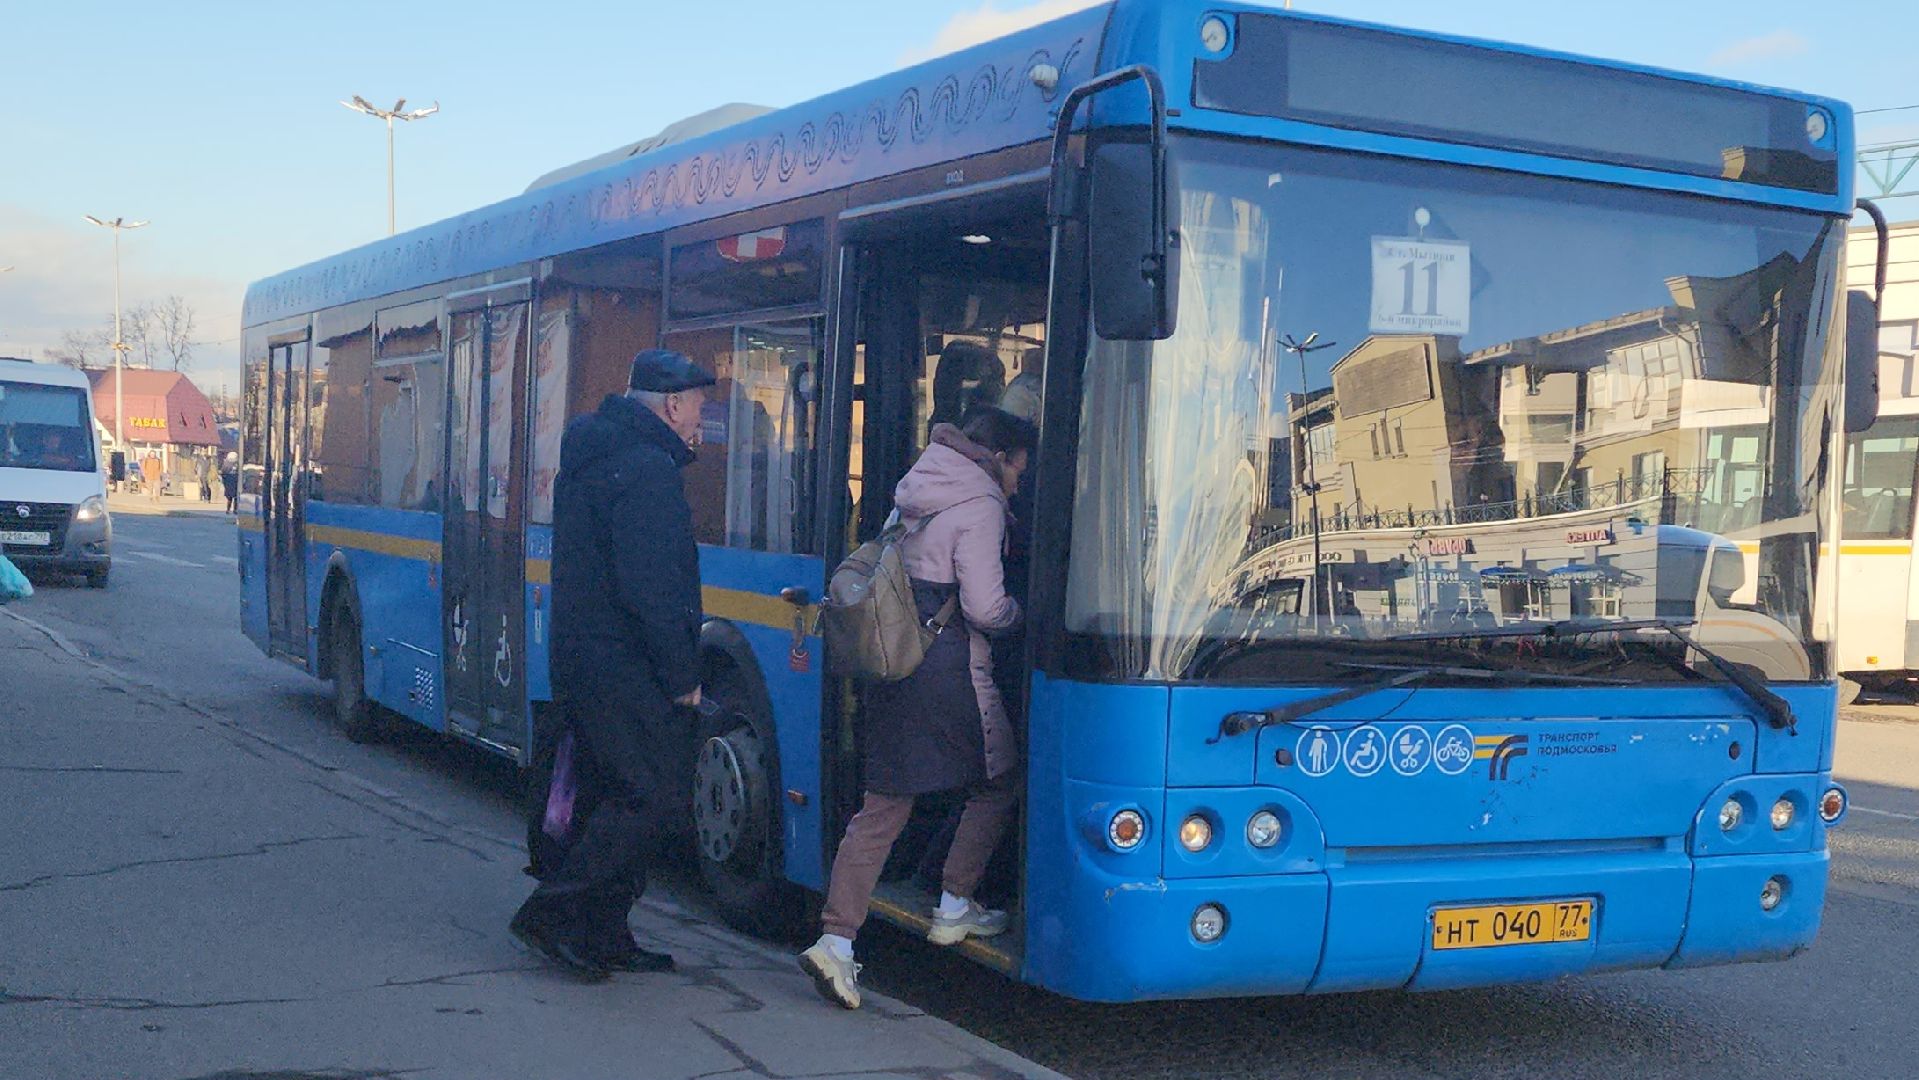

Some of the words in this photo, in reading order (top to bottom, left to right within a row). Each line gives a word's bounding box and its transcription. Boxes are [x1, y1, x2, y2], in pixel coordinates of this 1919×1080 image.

[1396, 261, 1443, 316] 11
[129, 416, 166, 429] ТАБАК
[1538, 732, 1600, 743] ТРАНСПОРТ
[1537, 744, 1617, 756] ПОДМОСКОВЬЯ
[1448, 920, 1479, 943] НТ
[1493, 910, 1541, 940] 040
[1559, 904, 1583, 928] 77
[1559, 928, 1577, 938] RUS
